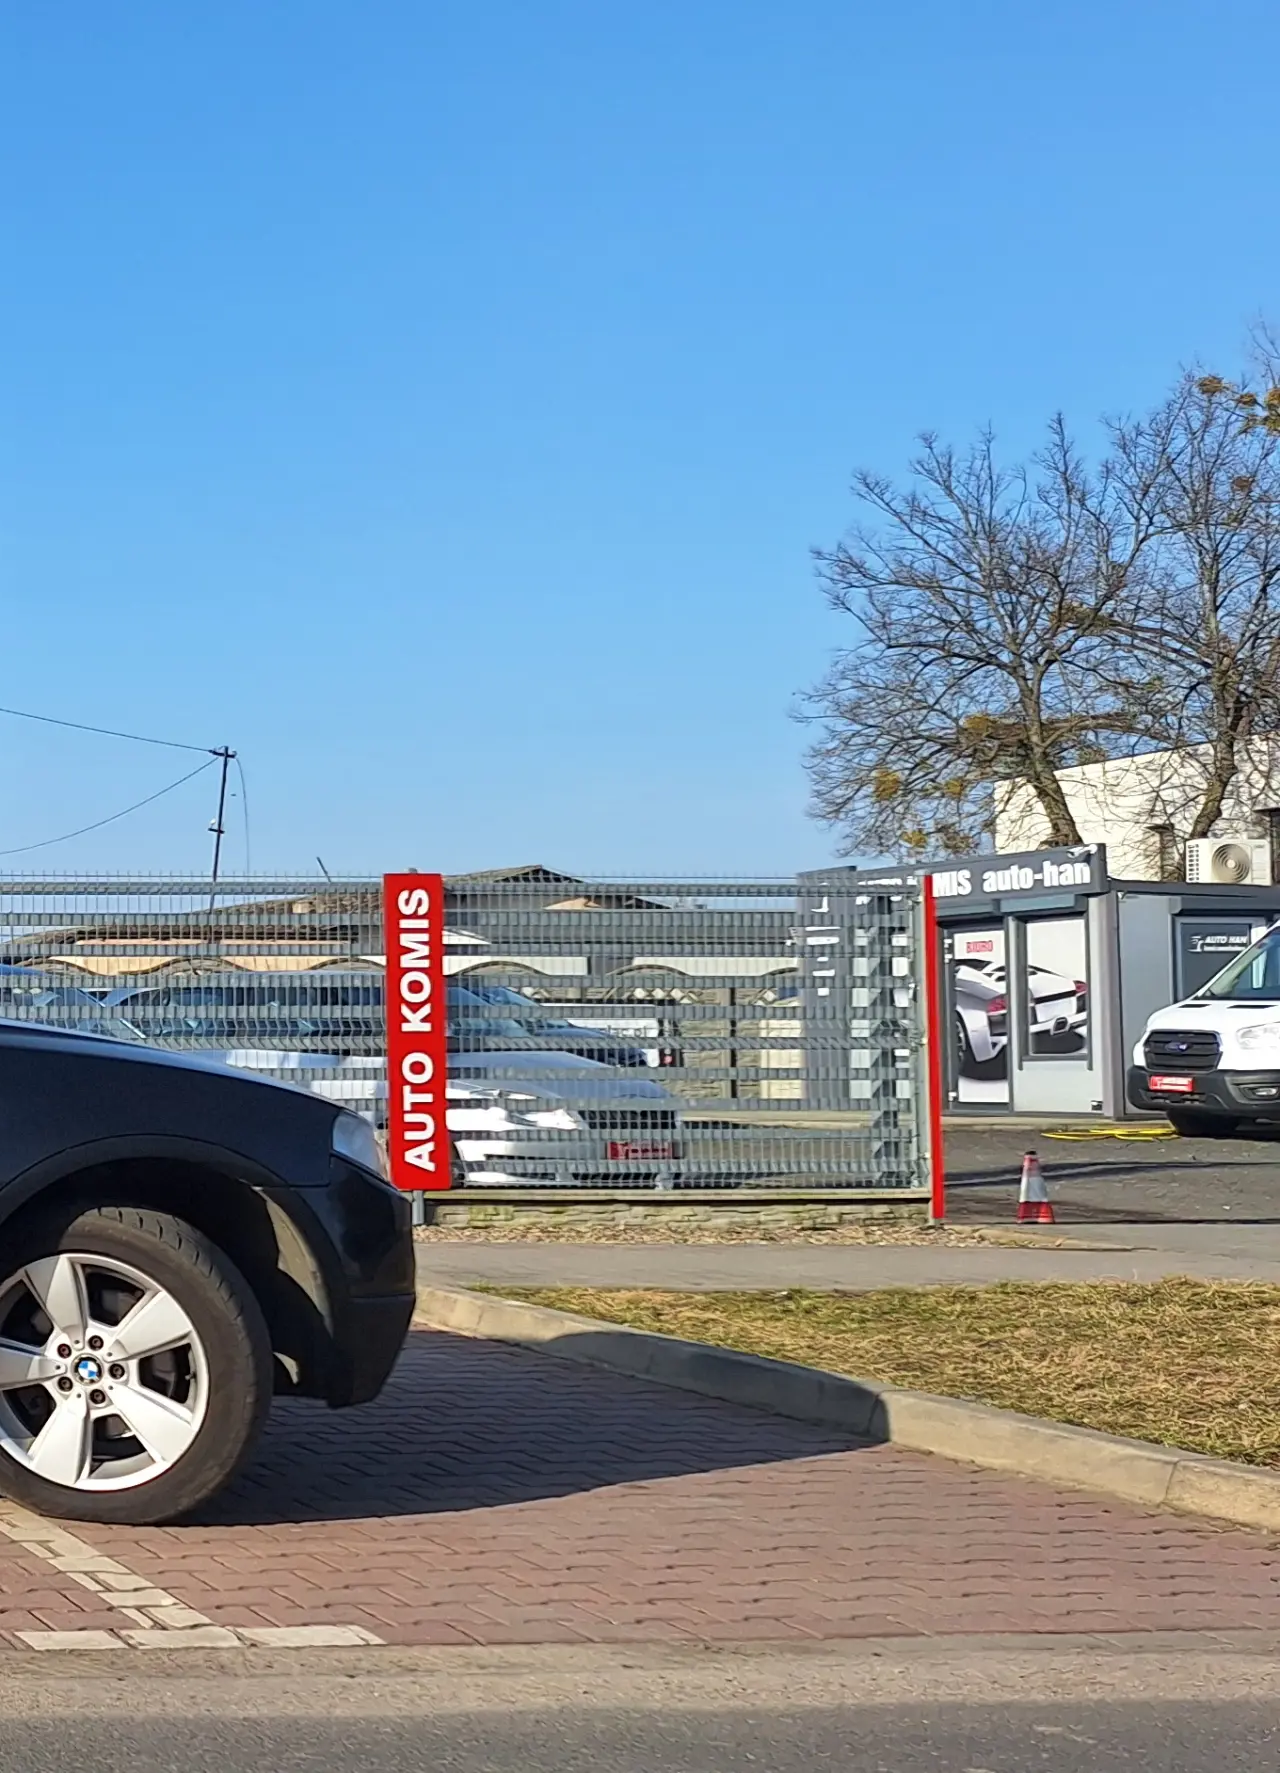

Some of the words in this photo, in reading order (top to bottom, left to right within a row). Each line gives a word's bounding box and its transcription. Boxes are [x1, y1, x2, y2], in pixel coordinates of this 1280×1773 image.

[982, 860, 1091, 893] auto-han
[397, 887, 432, 1033] KOMIS
[401, 1051, 436, 1172] AUTO
